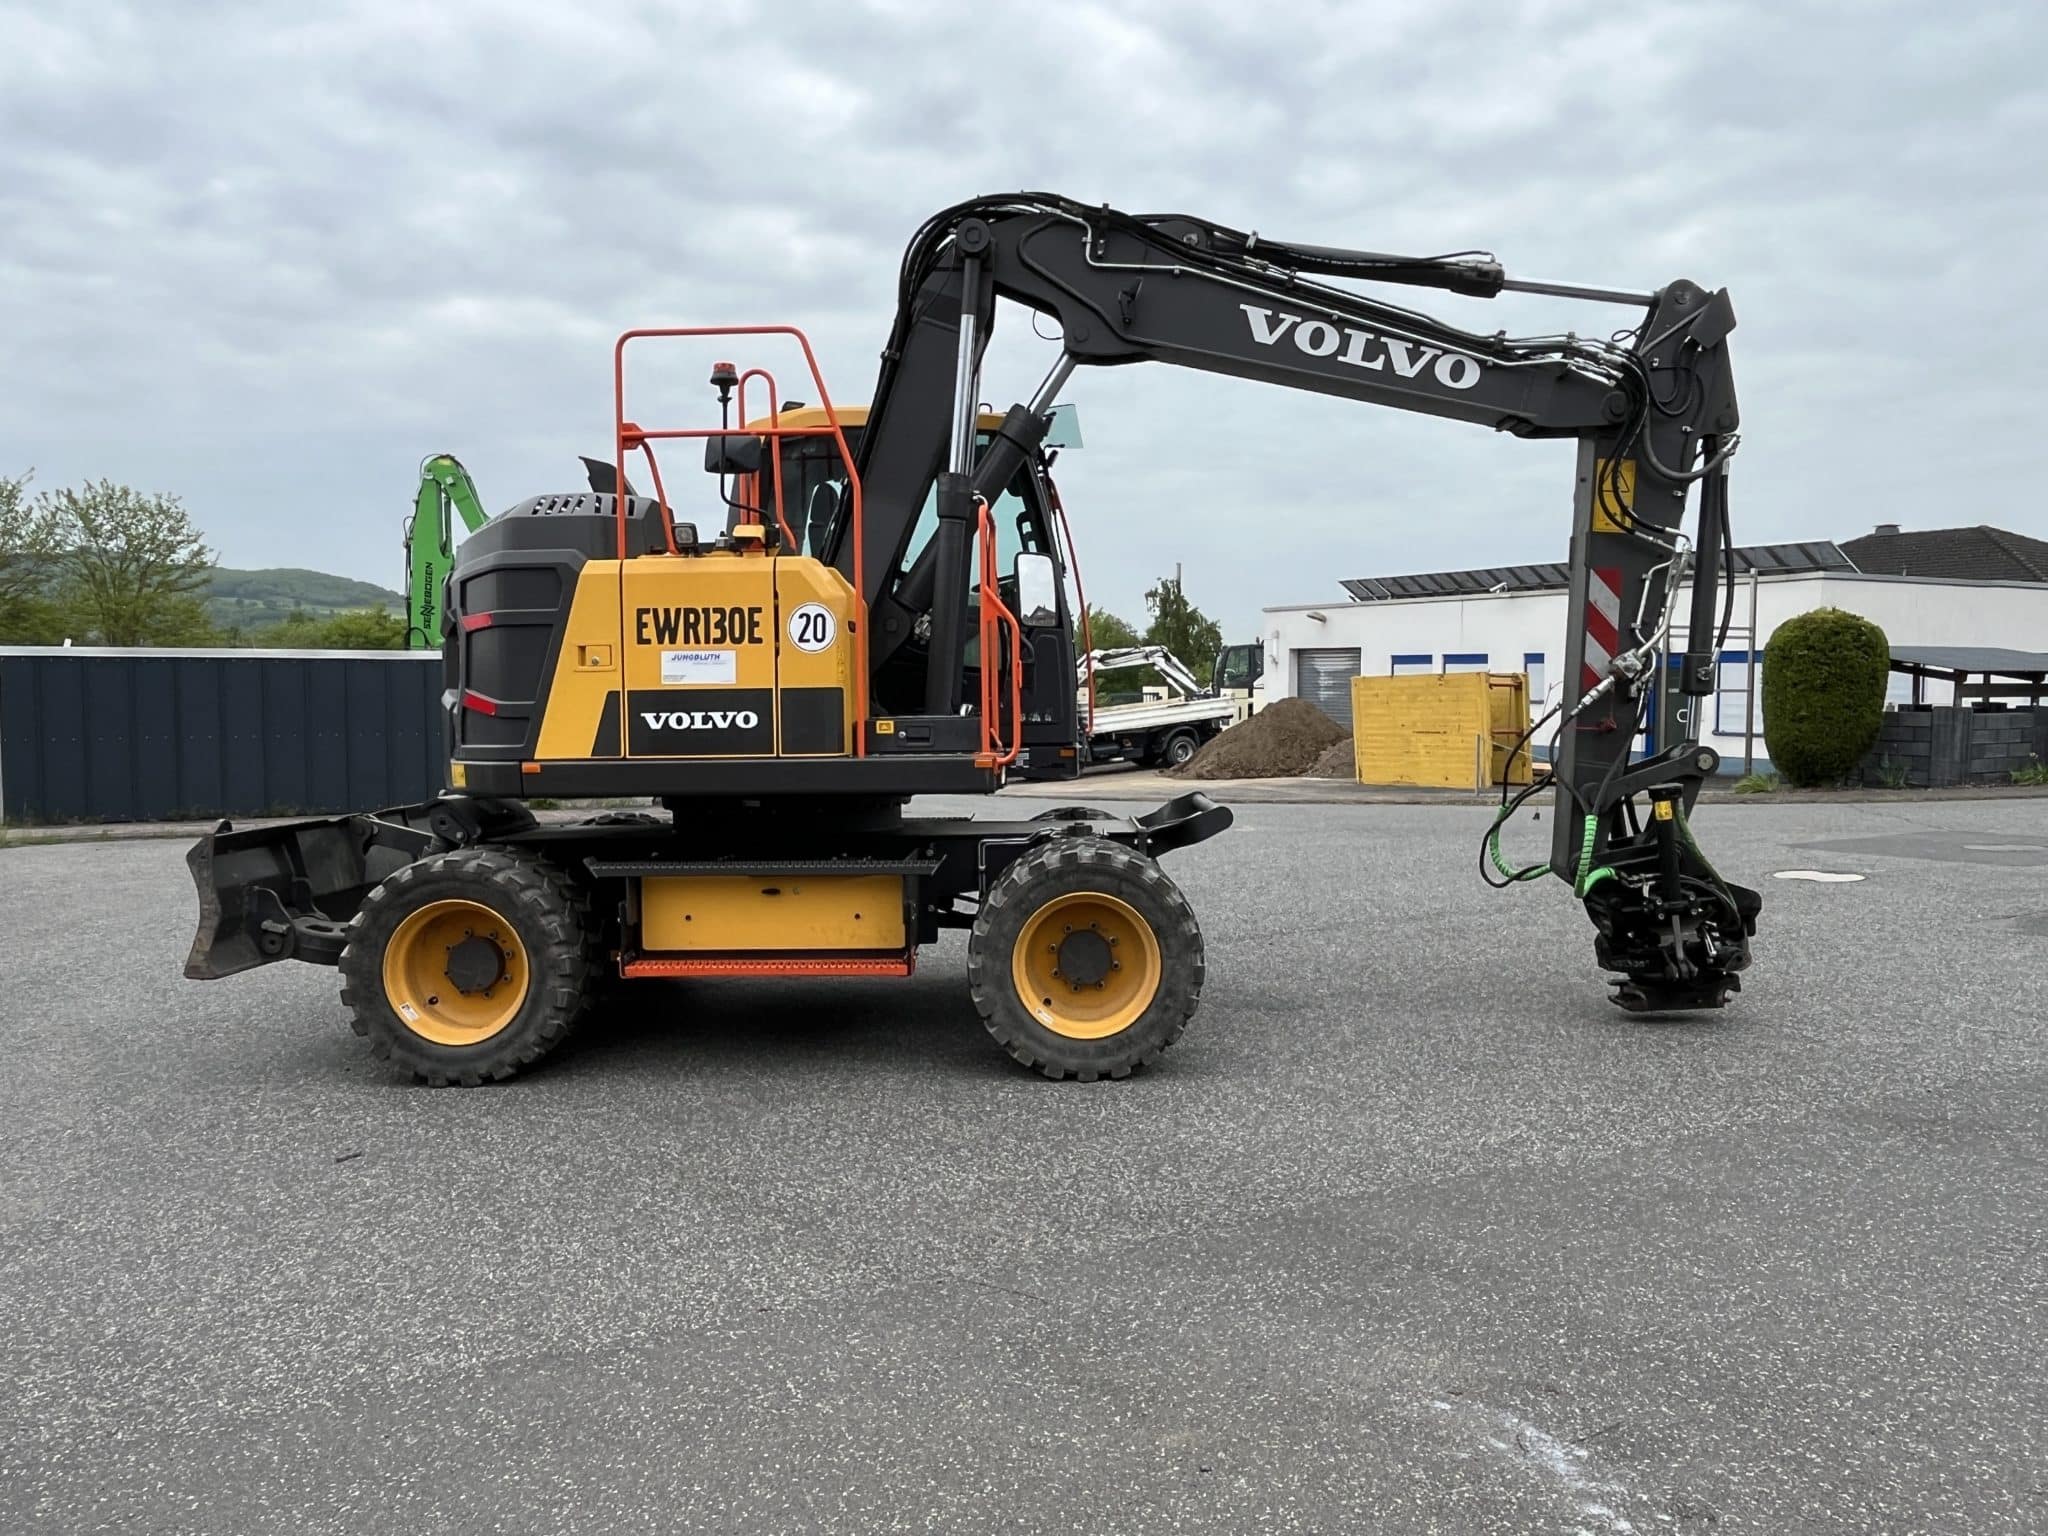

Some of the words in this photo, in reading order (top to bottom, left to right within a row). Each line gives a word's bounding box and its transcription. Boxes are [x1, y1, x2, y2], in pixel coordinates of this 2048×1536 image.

[1239, 303, 1481, 390] VOLVO
[636, 606, 763, 645] EWR130E
[798, 612, 826, 643] 20
[671, 653, 721, 661] JUNGBLUTH
[640, 711, 758, 730] VOLVO
